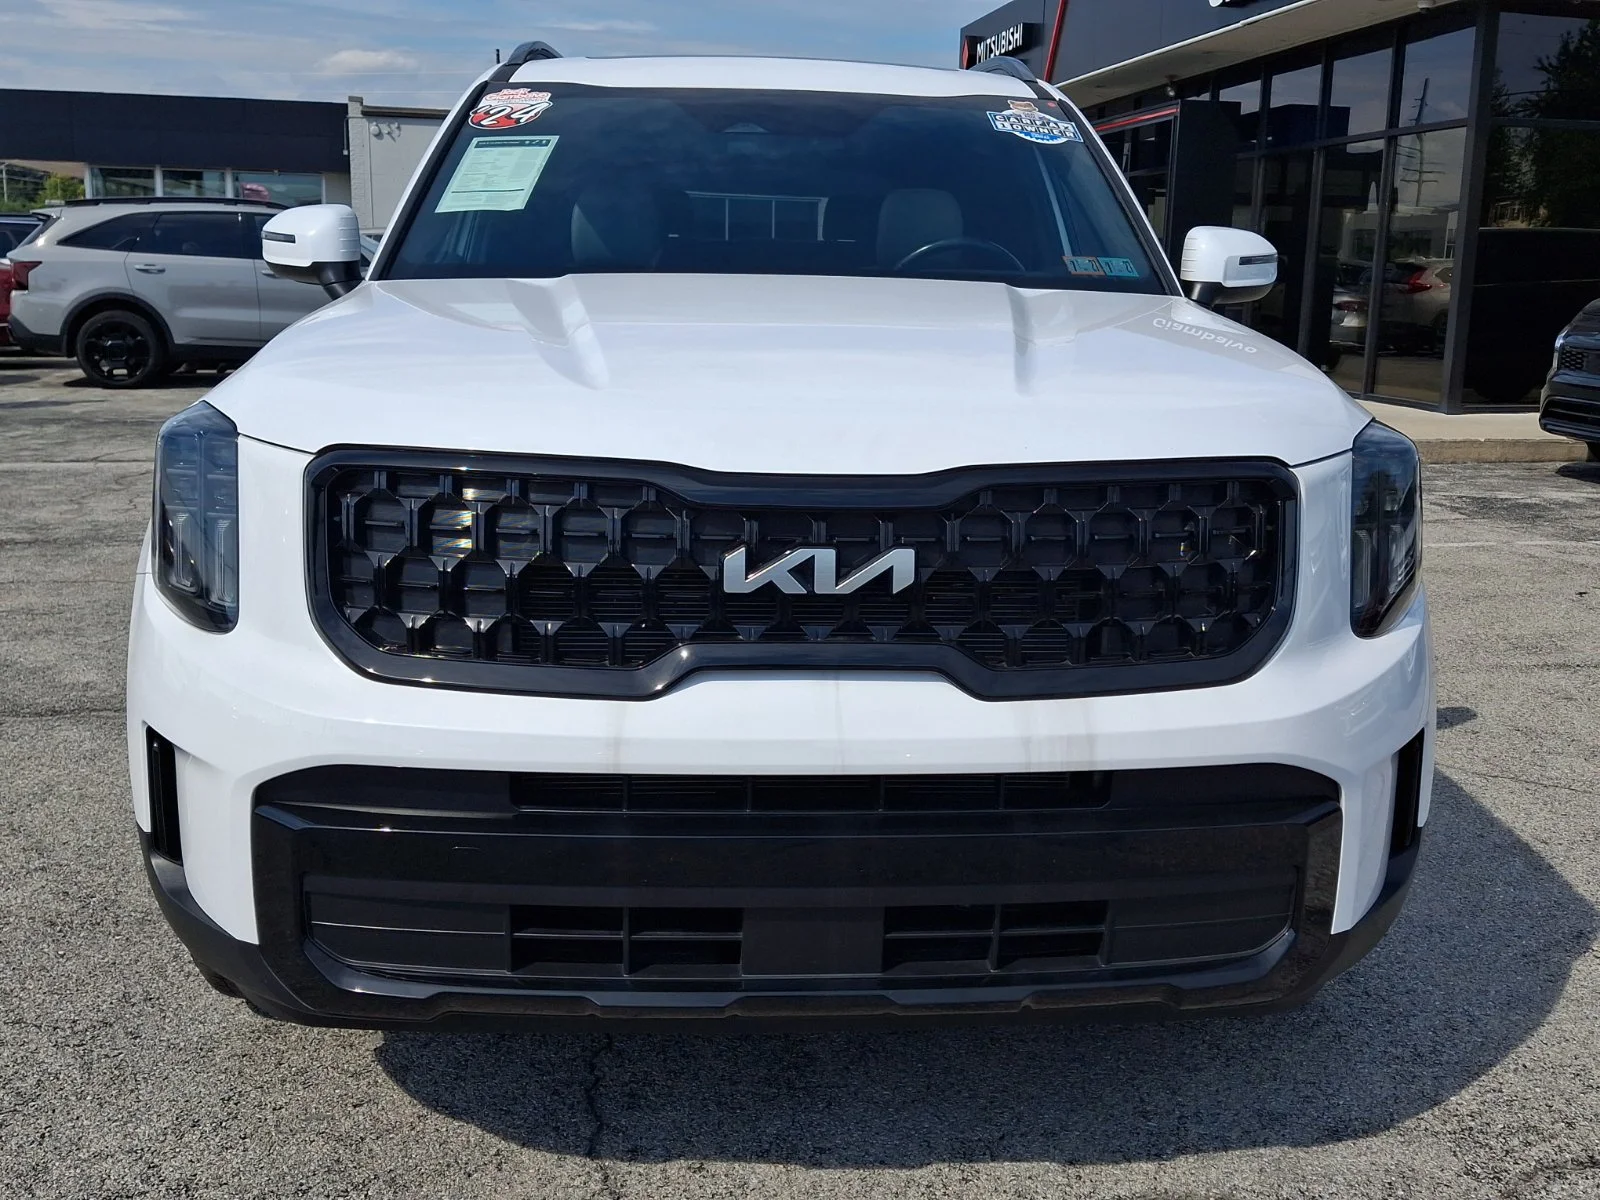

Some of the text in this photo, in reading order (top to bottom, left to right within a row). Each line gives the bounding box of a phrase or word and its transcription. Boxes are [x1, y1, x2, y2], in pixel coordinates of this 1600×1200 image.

[976, 22, 1023, 64] MITSUBISHI
[994, 114, 1072, 132] CARFAX
[723, 546, 915, 594] KIA
